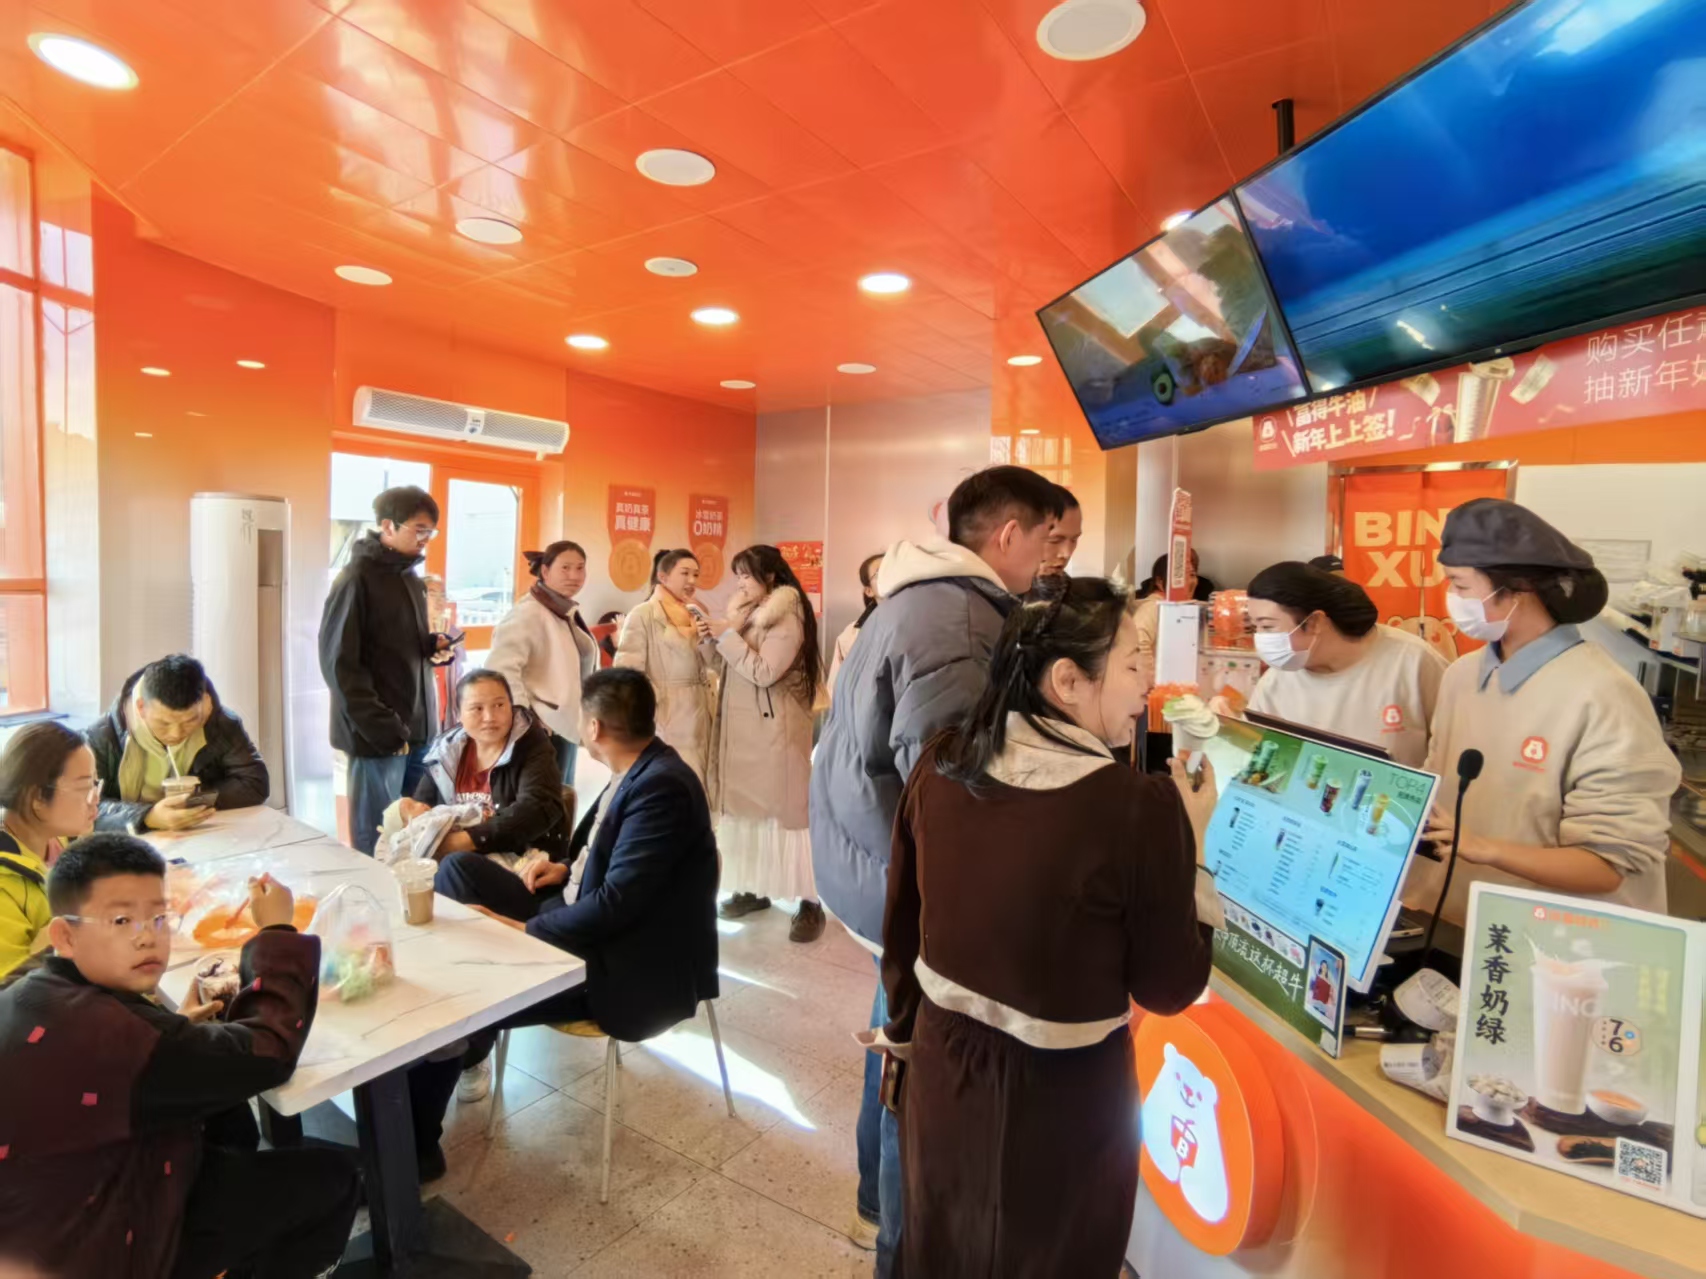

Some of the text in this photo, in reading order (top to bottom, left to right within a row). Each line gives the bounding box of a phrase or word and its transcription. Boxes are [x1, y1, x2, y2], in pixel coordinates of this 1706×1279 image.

[1475, 923, 1514, 1045] 茉香奶绿
[1609, 1019, 1624, 1036] 7
[1609, 1037, 1624, 1053] 6
